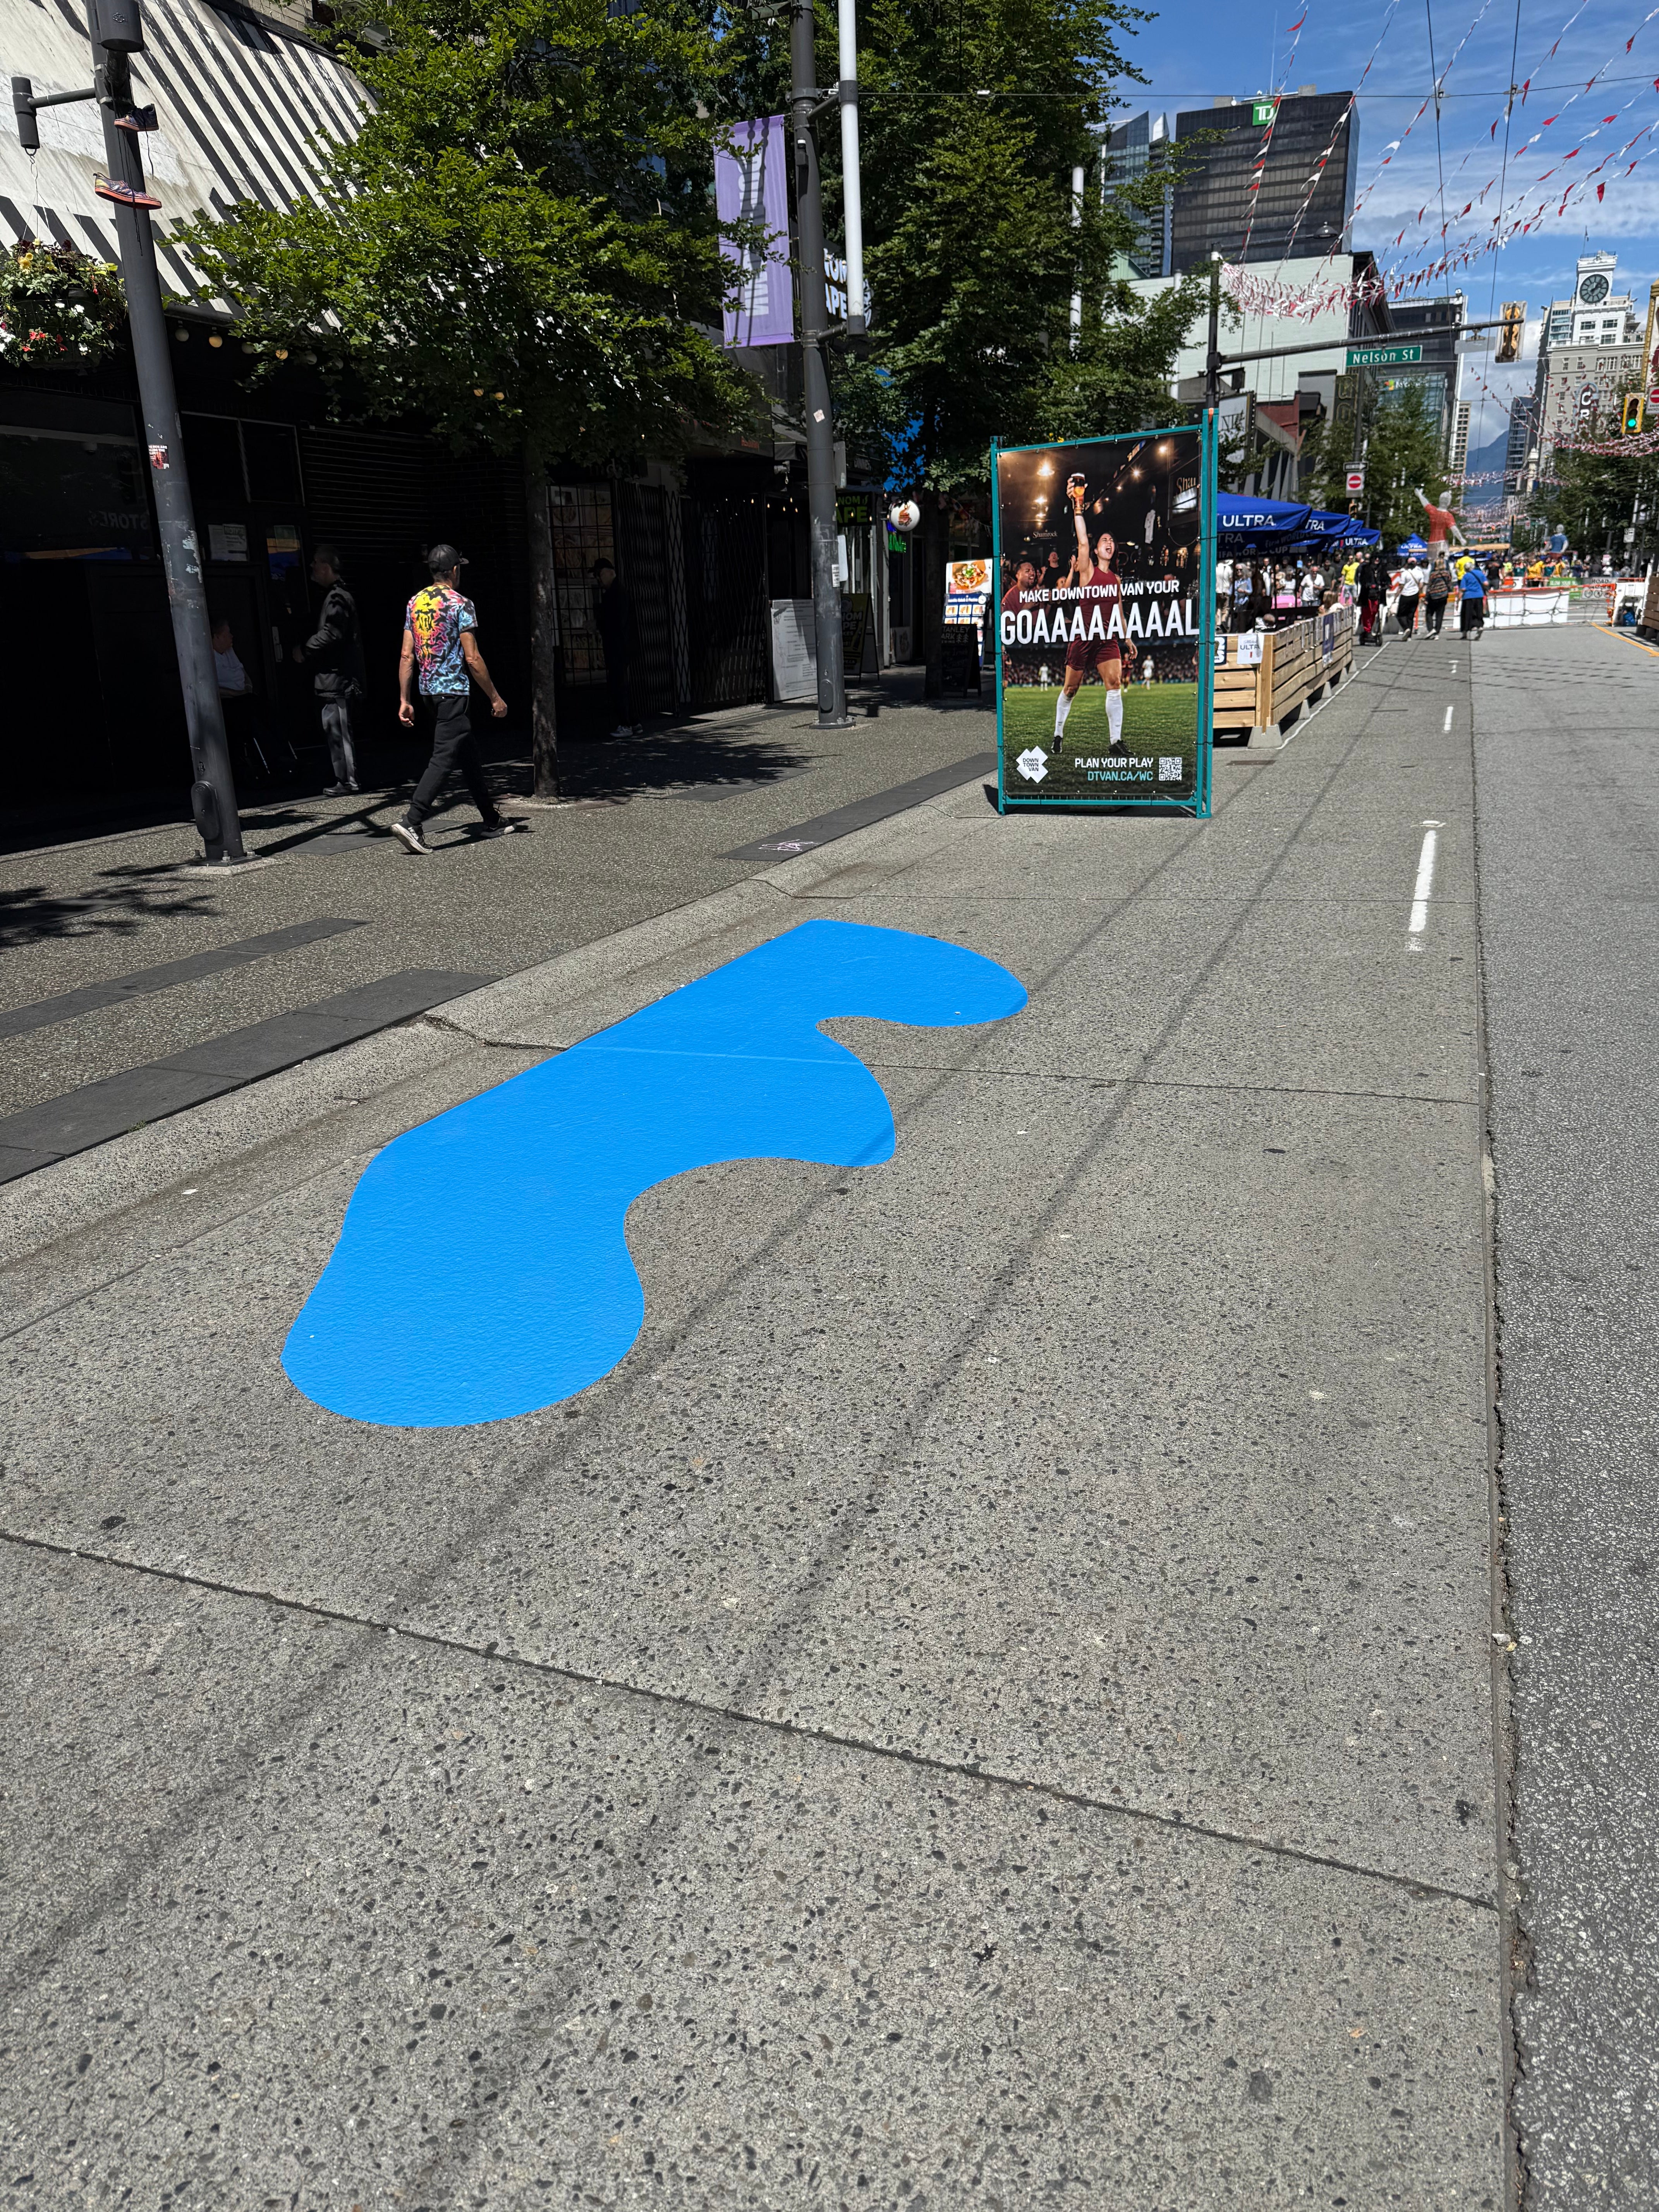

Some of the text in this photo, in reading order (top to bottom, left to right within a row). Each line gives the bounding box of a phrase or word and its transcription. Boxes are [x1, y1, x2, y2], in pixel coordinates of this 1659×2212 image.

[1255, 105, 1274, 120] TD
[1353, 349, 1414, 364] Nelson St
[1223, 515, 1276, 527] ULTRA
[1305, 519, 1326, 531] TRA
[1218, 532, 1244, 544] TRA
[1345, 538, 1369, 546] ULTRA
[1019, 579, 1180, 603] MAKE DOWNTOWN VAN YOUR
[1001, 599, 1199, 646] GOAAAAAAAAL
[942, 625, 970, 634] TANLEY
[1075, 757, 1154, 768] PLAN YOUR PLAY
[1087, 771, 1154, 781] DTVAN.CA/WC
